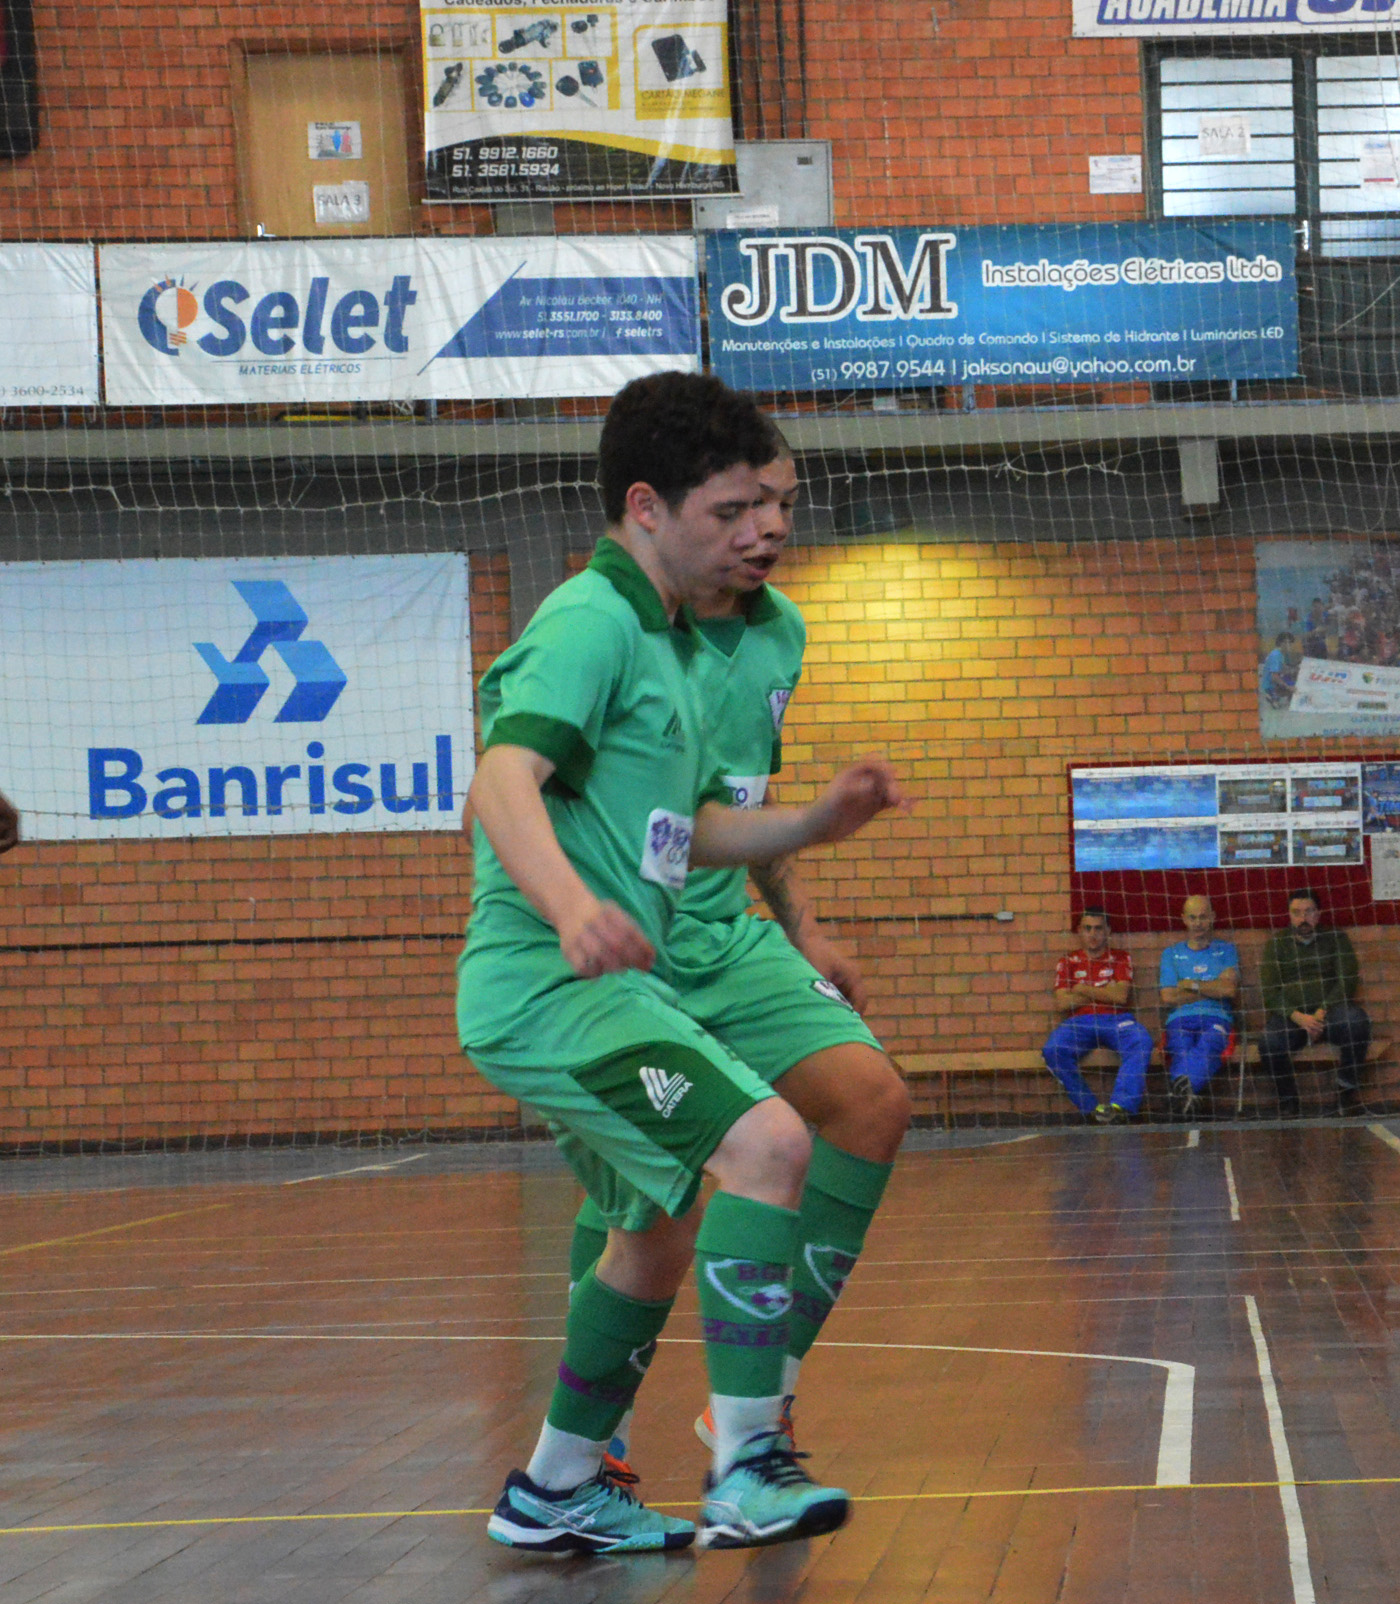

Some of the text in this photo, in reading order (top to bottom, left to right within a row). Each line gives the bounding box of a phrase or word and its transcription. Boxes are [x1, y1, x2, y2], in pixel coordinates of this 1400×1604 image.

[478, 146, 558, 160] 9912.1660
[478, 163, 559, 177] 3581.5934
[722, 233, 957, 325] JDM
[984, 255, 1281, 290] Instalações Elétricas Ltda
[196, 275, 418, 356] Selet
[722, 339, 808, 353] Manutenções
[811, 340, 820, 349] e
[824, 336, 896, 351] Instalações
[906, 334, 955, 349] Quadro
[958, 333, 975, 345] de
[978, 332, 1039, 345] Comando
[1049, 331, 1100, 344] Sistema
[1104, 330, 1121, 343] de
[1125, 330, 1180, 342] Hidrante
[1191, 328, 1258, 341] Luminárias
[1260, 326, 1285, 340] LED
[239, 363, 361, 375] MATERIAIS ELÉTRICOS
[811, 367, 837, 382] (51)
[841, 360, 945, 380] 9987.9544
[961, 354, 1197, 380] jaksonaw@yahoo.com.br
[11, 385, 84, 396] 3600-2534
[88, 734, 455, 821] Banrisul
